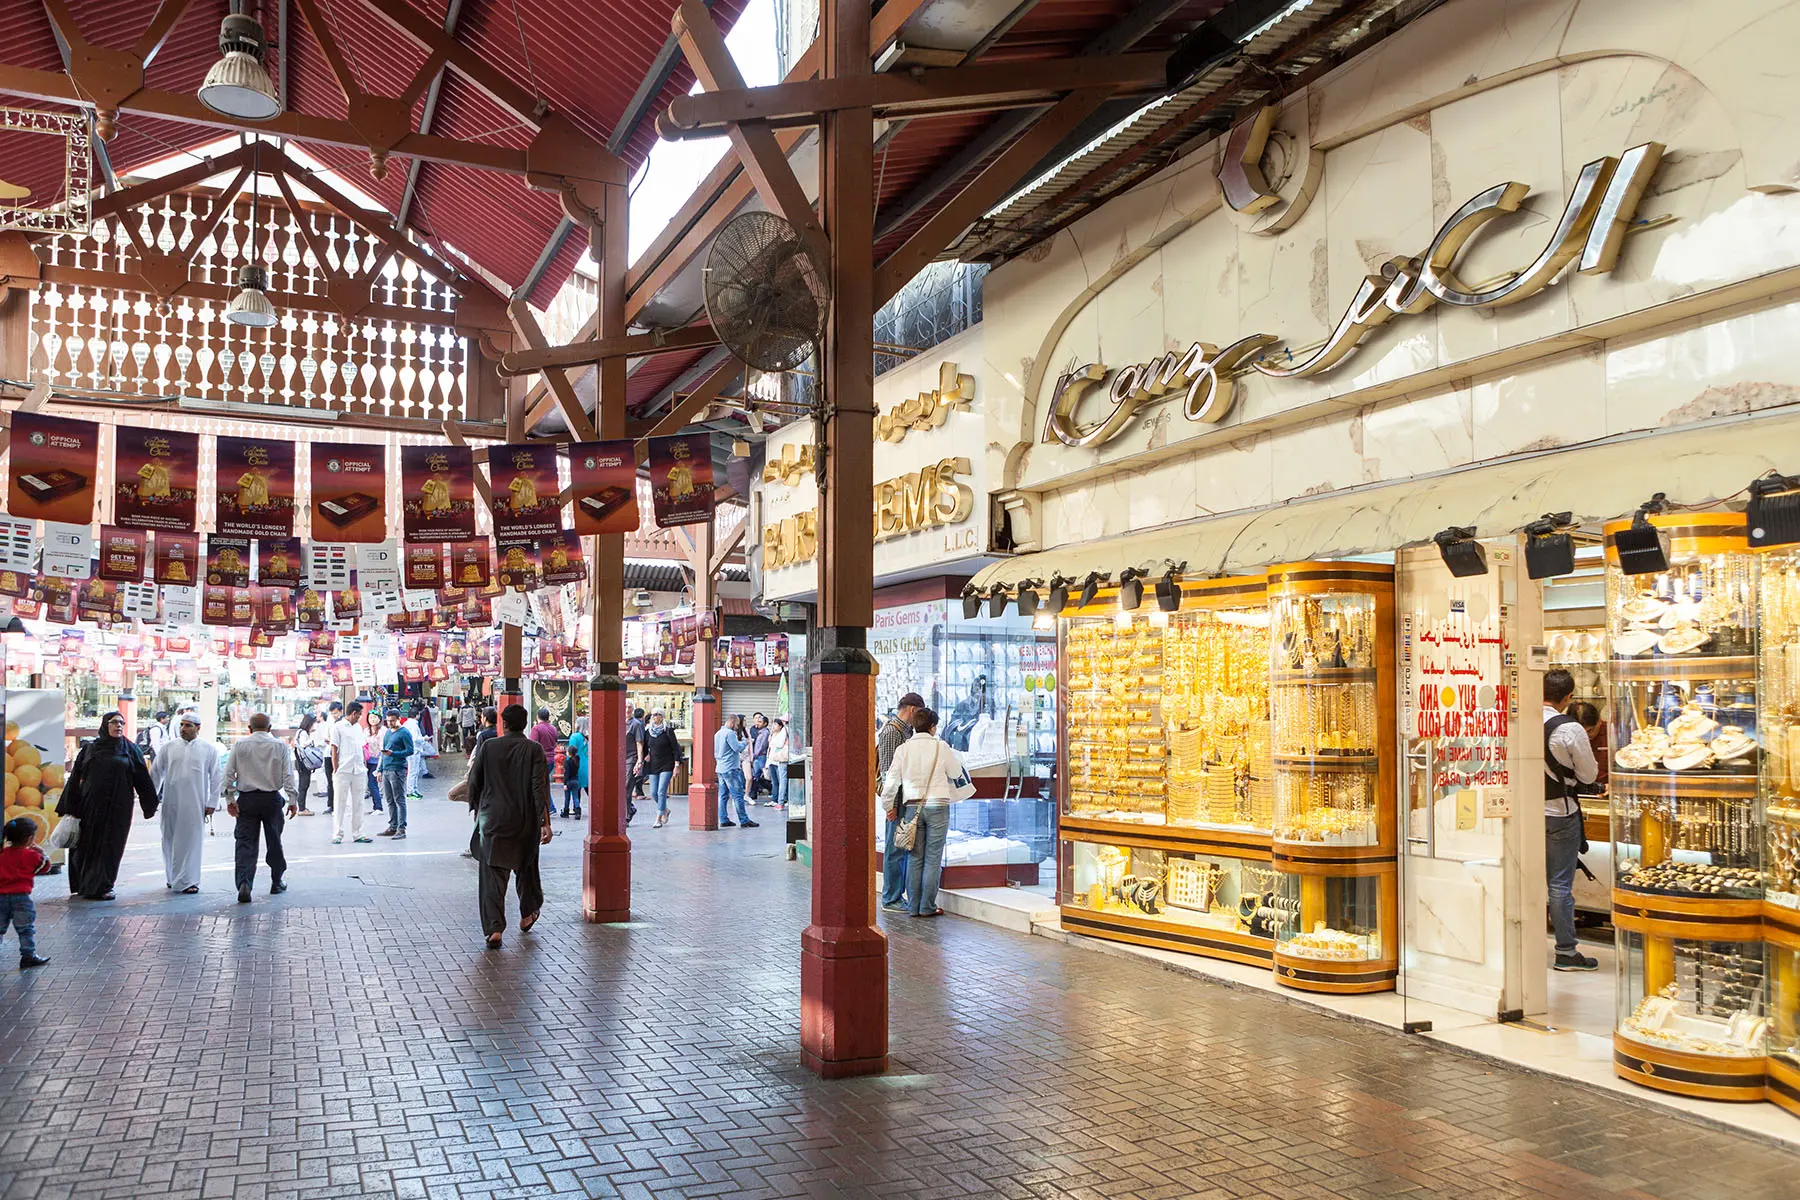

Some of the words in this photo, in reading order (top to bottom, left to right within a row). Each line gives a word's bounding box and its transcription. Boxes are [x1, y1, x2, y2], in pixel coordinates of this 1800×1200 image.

[50, 435, 81, 444] OFFICIAL
[50, 441, 82, 449] ATTEMPT
[763, 507, 818, 572] PAR
[874, 457, 974, 545] EMS
[943, 528, 979, 553] L.L.C.
[235, 522, 261, 530] WORLD'S
[261, 523, 287, 531] LONGEST
[222, 528, 254, 536] HANDMADE
[875, 612, 895, 628] Paris
[895, 611, 921, 626] Gems
[874, 638, 899, 655] PARIS
[900, 635, 926, 653] GEMS
